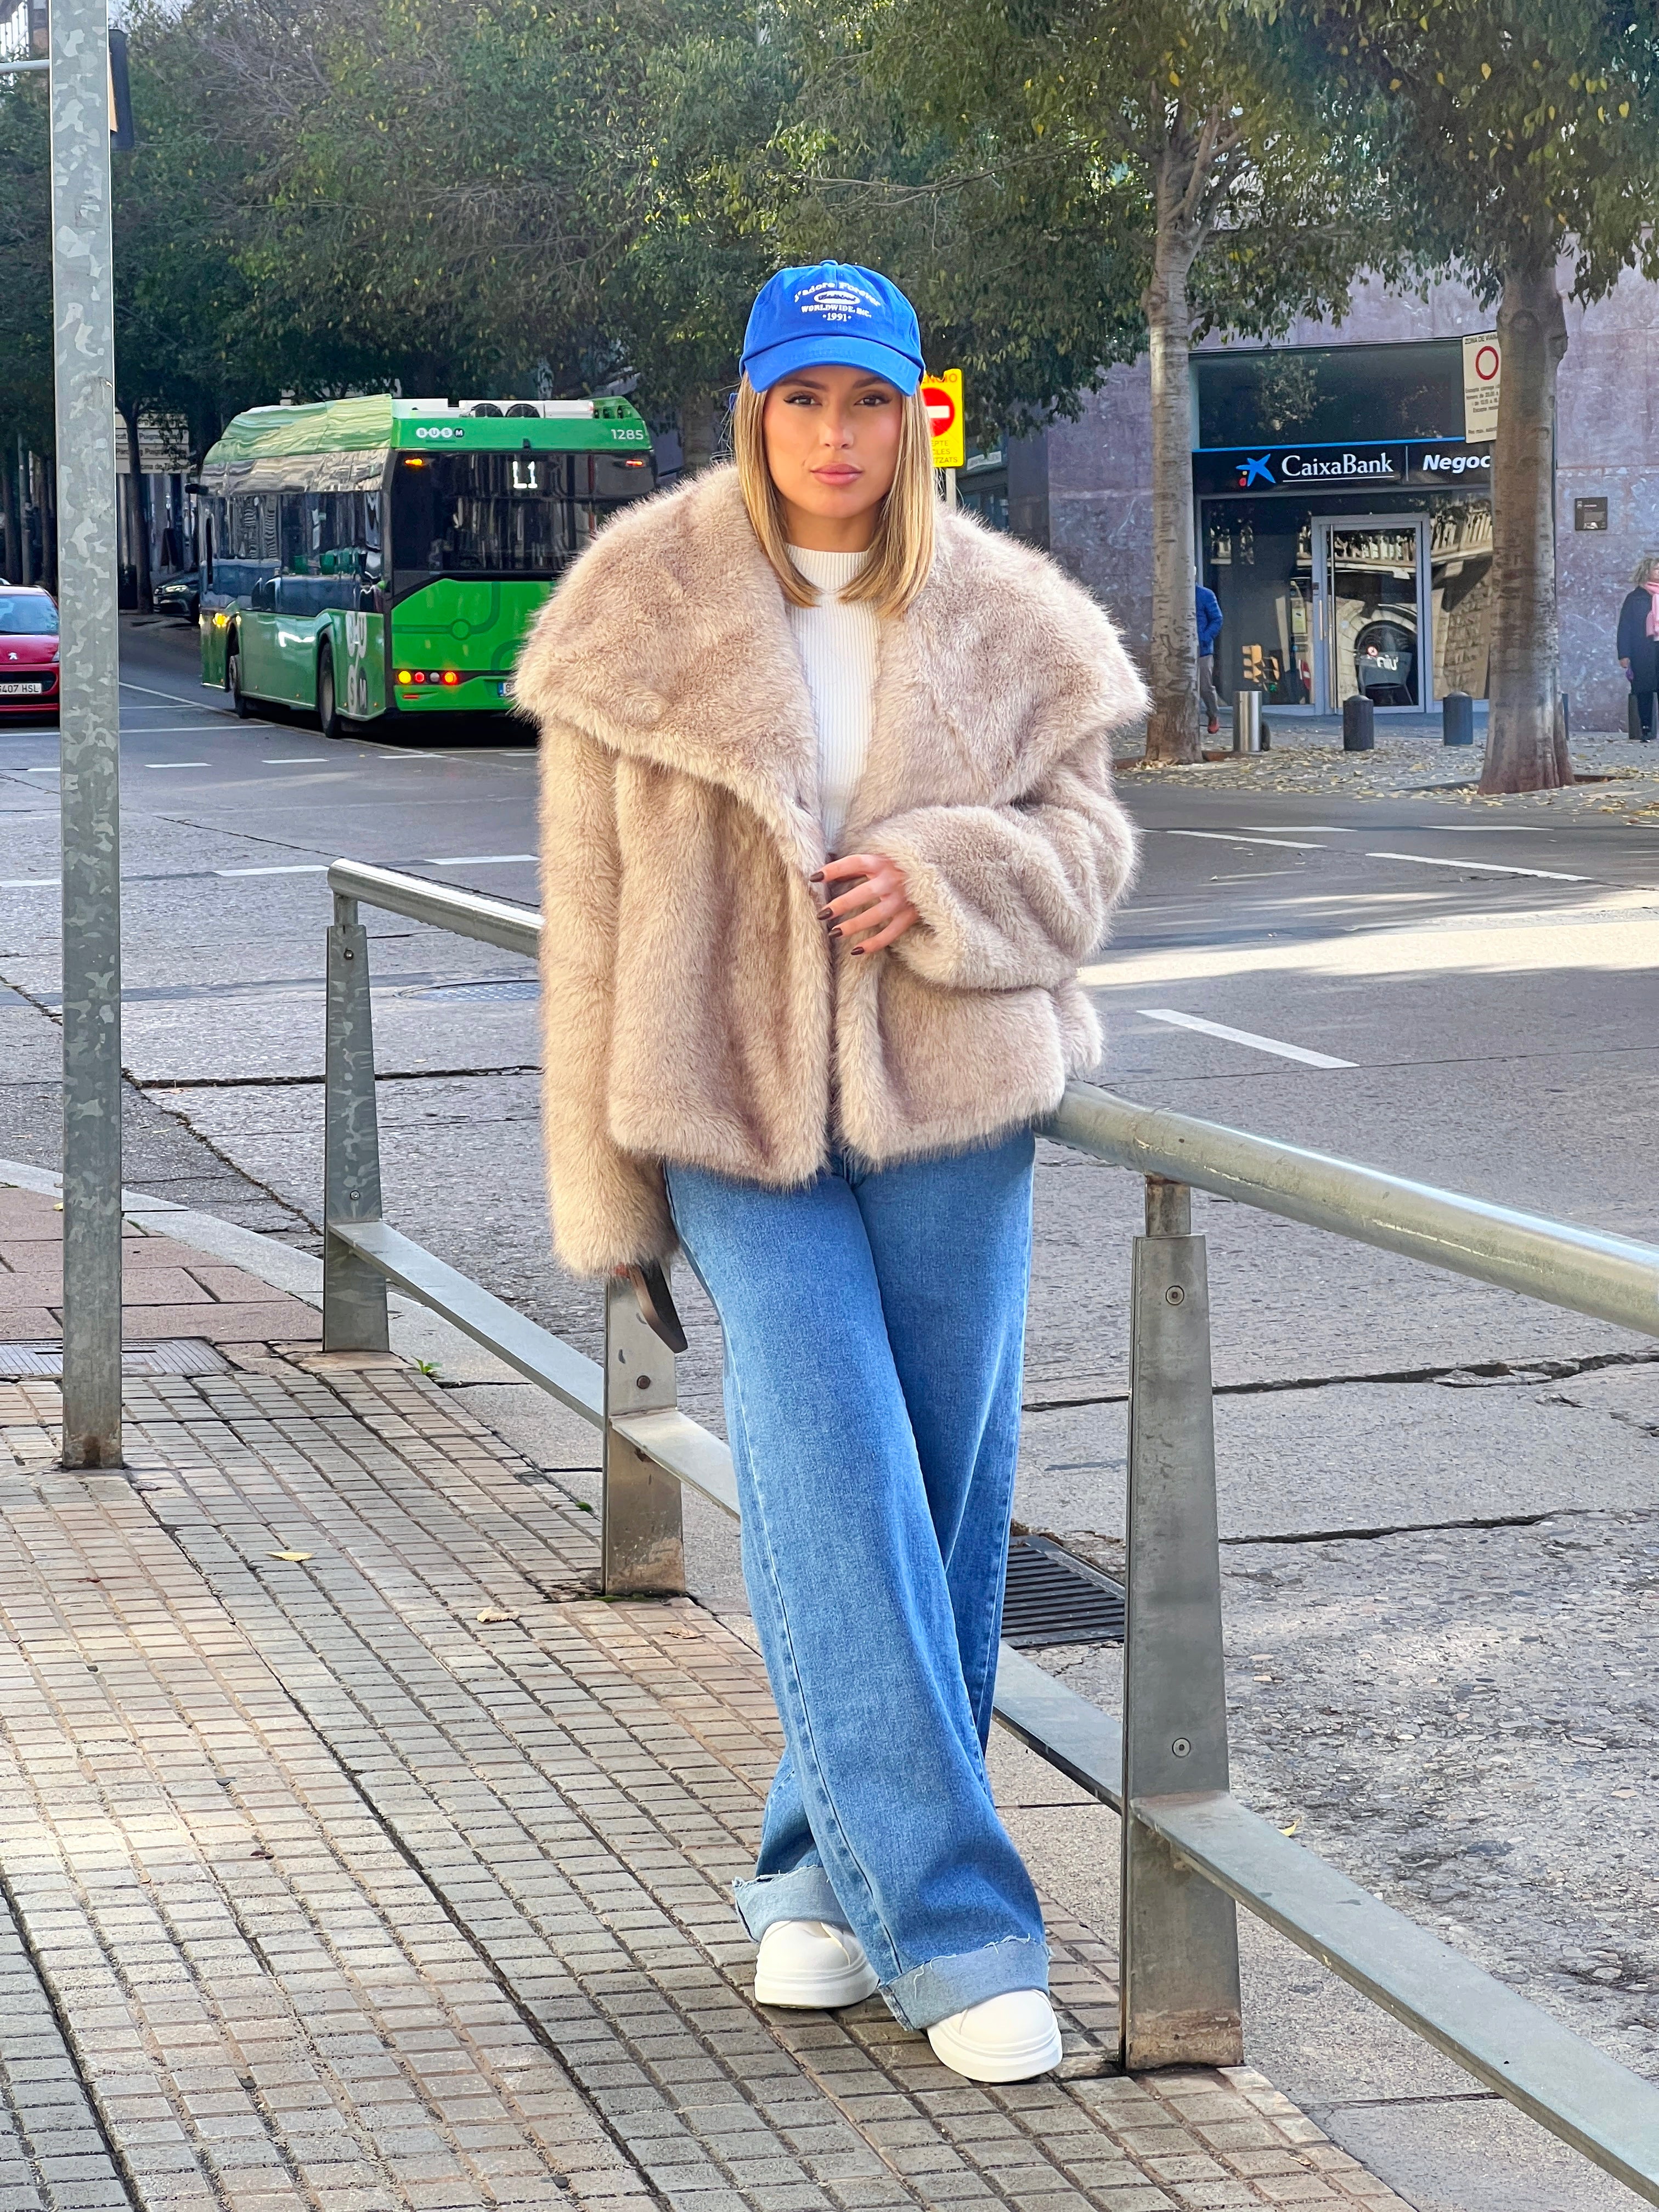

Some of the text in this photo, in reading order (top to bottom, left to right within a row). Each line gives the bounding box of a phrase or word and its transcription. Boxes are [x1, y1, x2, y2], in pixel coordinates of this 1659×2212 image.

[839, 281, 881, 307] Forever
[611, 429, 644, 440] 1285
[512, 461, 538, 489] L1
[1282, 452, 1491, 476] CaixaBank Negoc
